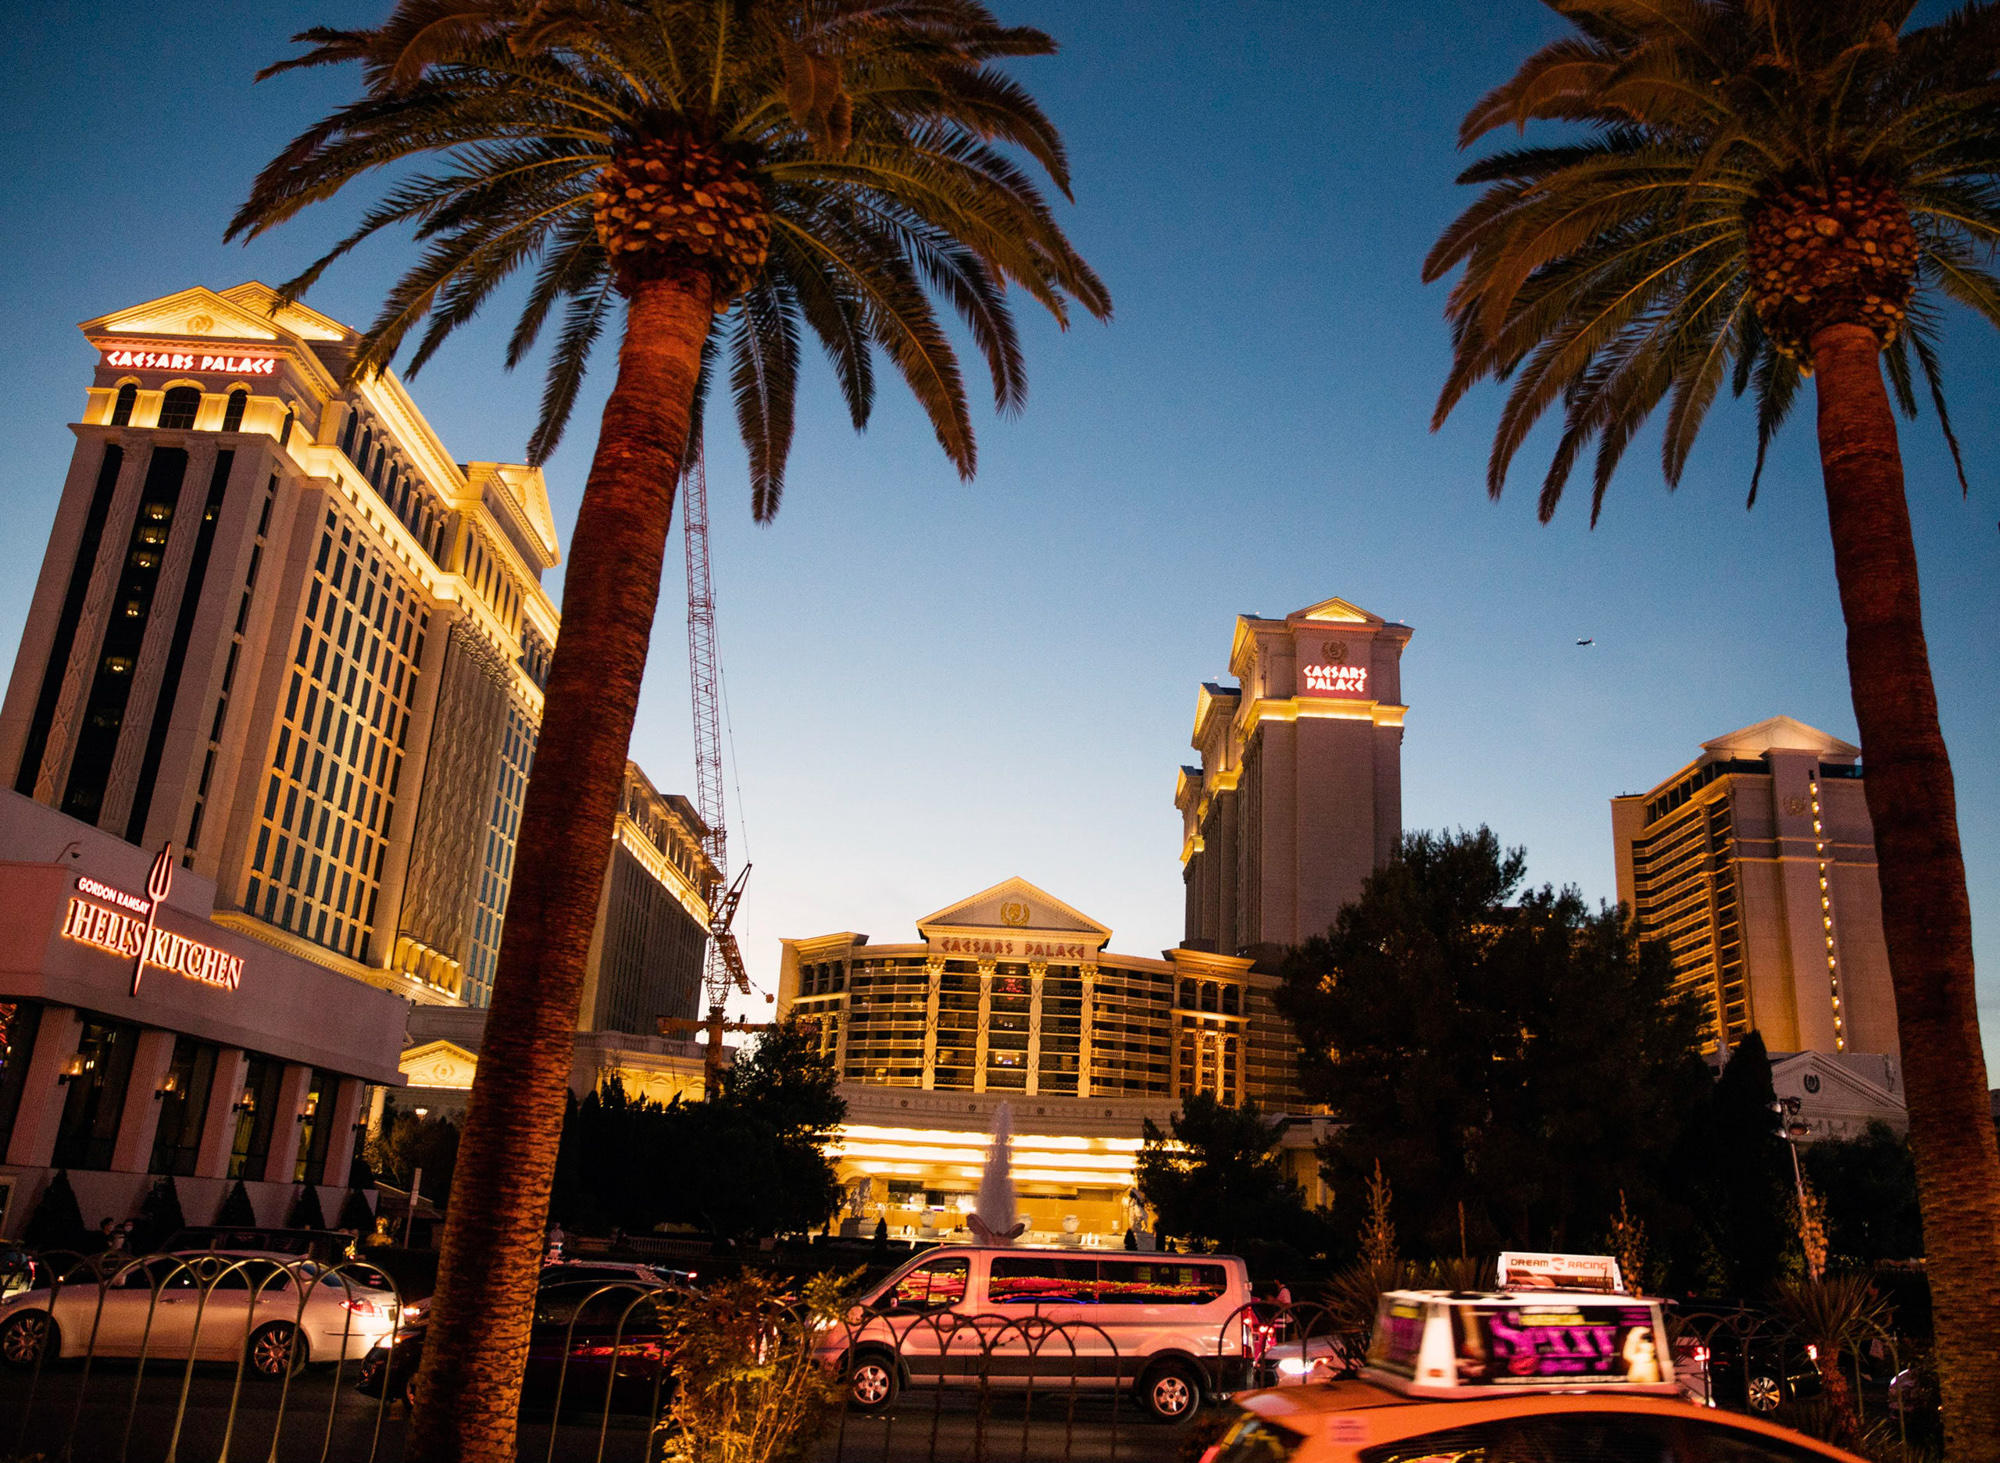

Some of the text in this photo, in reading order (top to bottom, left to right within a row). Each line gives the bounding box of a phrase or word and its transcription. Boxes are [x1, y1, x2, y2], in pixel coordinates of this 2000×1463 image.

[107, 350, 276, 374] CAESARS PALACE
[1303, 665, 1368, 692] CAESARS PALACE
[78, 876, 150, 915] GORDON RAMSAY
[68, 899, 245, 990] HELL'S KITCHEN
[941, 938, 1085, 959] CAESARS PALACE
[1510, 1258, 1608, 1270] DREAM RACING
